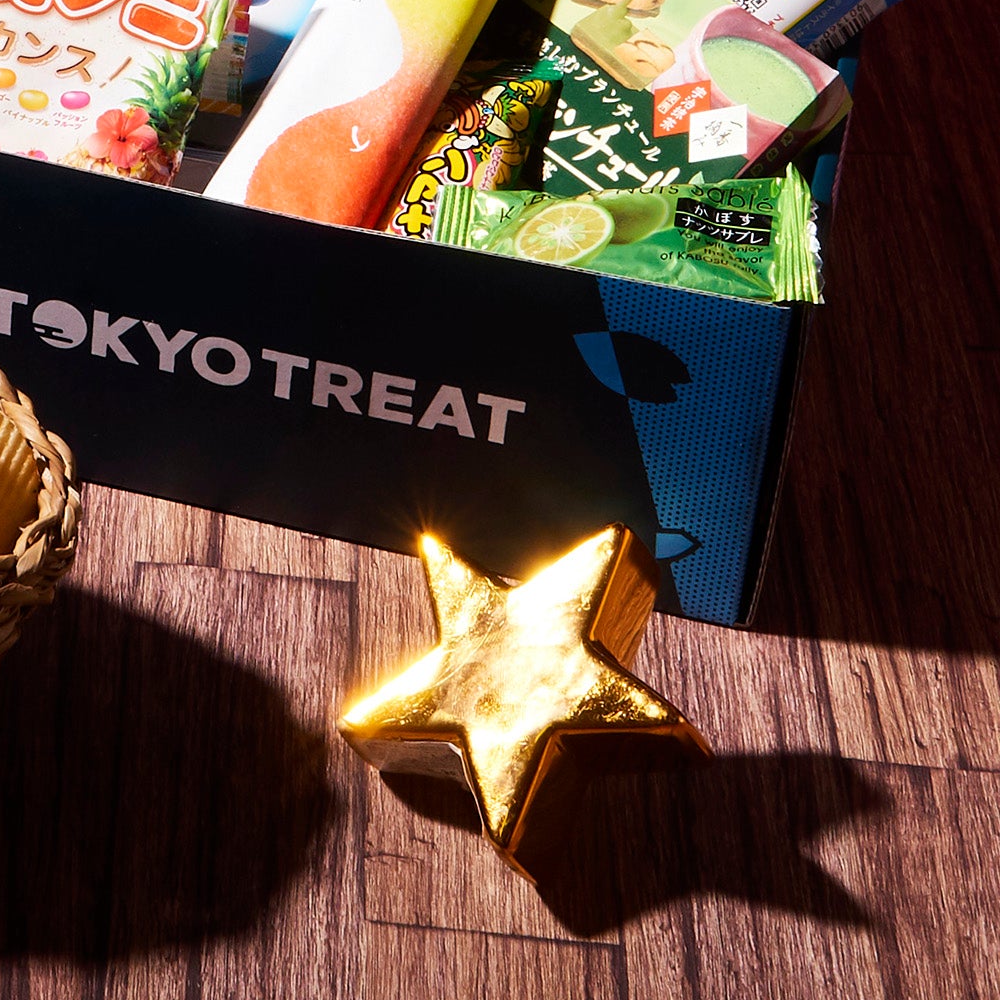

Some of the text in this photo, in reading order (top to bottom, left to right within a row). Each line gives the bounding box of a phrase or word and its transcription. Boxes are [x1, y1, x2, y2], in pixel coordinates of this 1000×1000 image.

[693, 204, 755, 227] かぼす
[681, 215, 765, 245] ナッツサブレ
